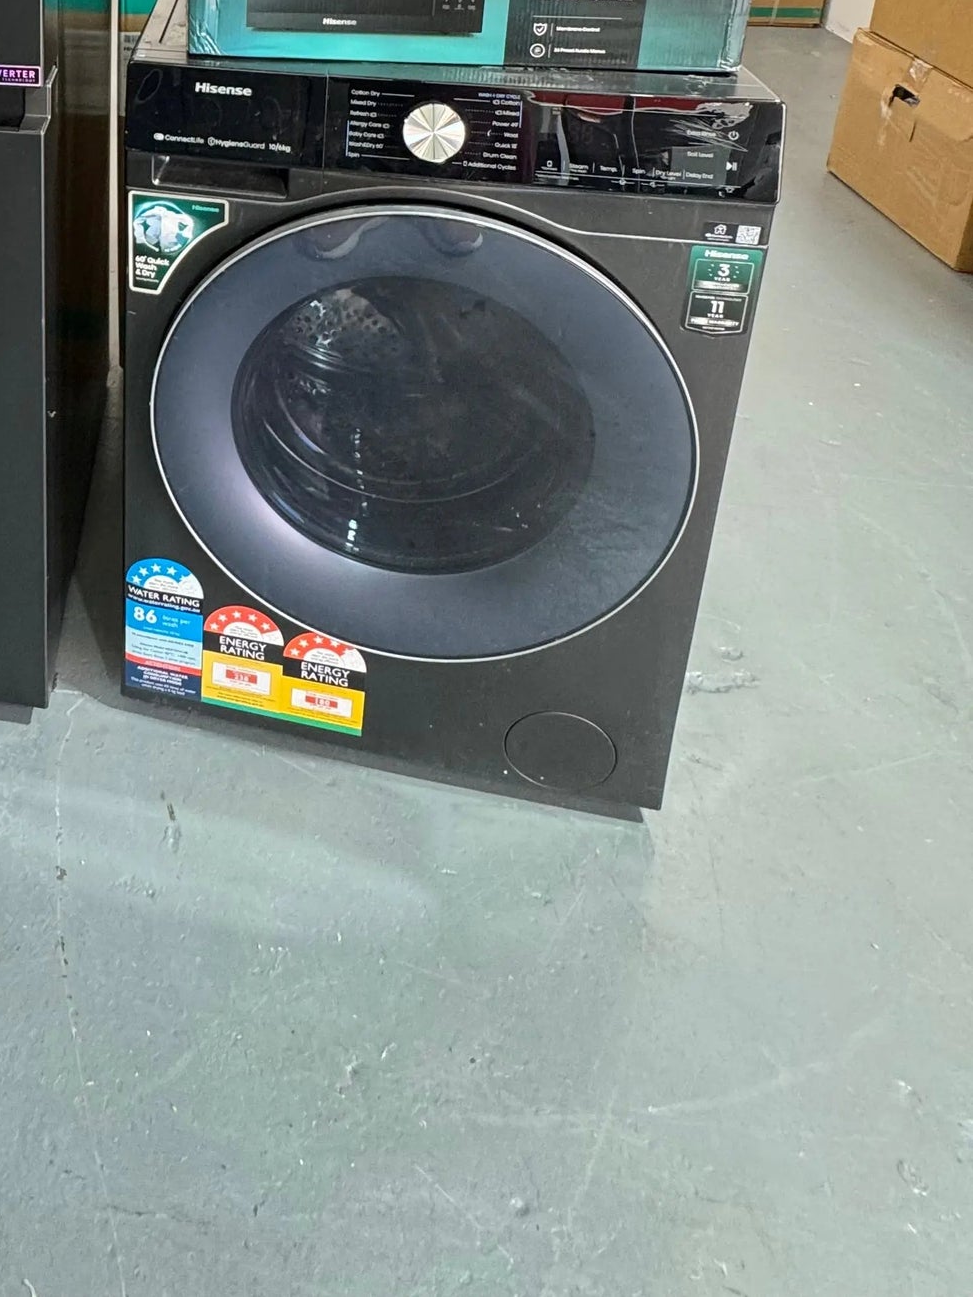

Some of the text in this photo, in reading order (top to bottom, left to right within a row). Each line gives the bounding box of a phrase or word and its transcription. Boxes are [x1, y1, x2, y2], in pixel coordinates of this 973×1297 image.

[195, 82, 252, 96] Hisense
[147, 257, 169, 266] Quick
[704, 249, 749, 260] Hisense
[135, 262, 157, 271] Wash
[718, 263, 730, 276] 3
[142, 270, 155, 278] Dry
[711, 300, 724, 313] 11
[128, 585, 160, 600] WATER
[162, 594, 200, 607] RATING
[133, 606, 157, 624] 86
[219, 636, 266, 652] ENERGY
[220, 645, 264, 660] RATING
[301, 662, 350, 678] ENERGY
[301, 670, 348, 687] RATING
